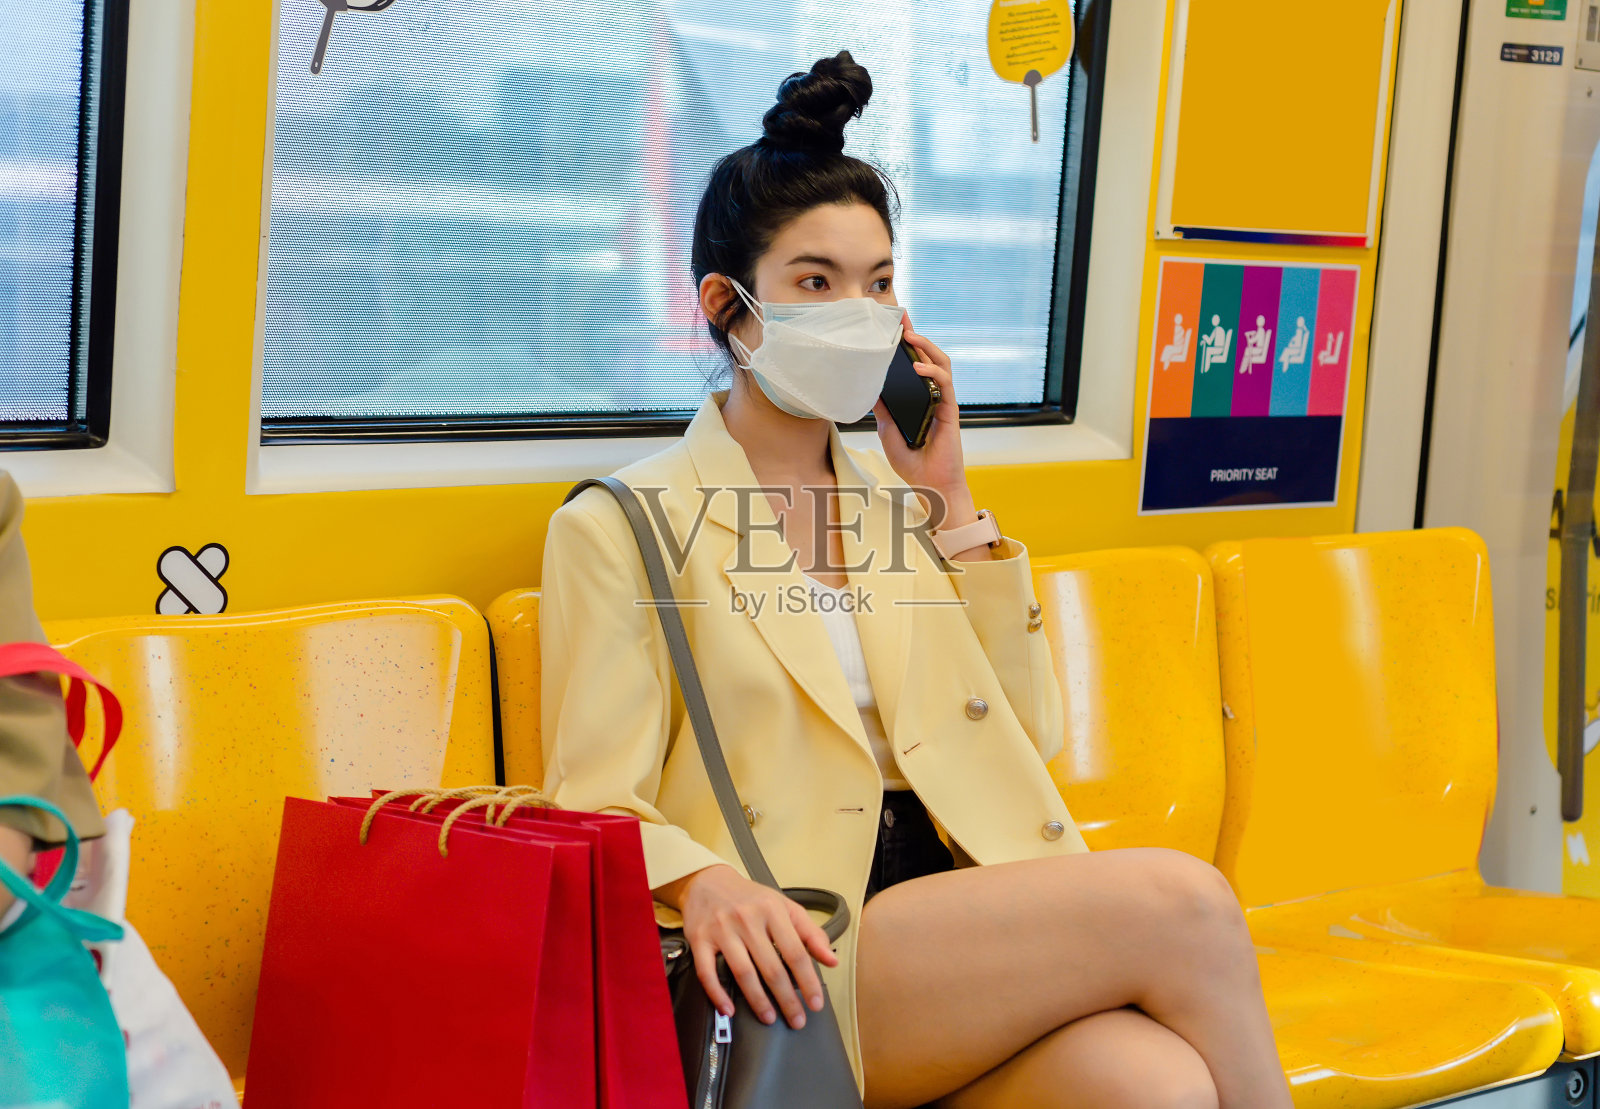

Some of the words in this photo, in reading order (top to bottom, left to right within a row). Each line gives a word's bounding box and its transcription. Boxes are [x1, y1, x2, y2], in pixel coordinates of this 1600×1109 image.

[1531, 49, 1560, 63] 3129
[1210, 469, 1254, 482] PRIORITY
[1255, 467, 1278, 480] SEAT
